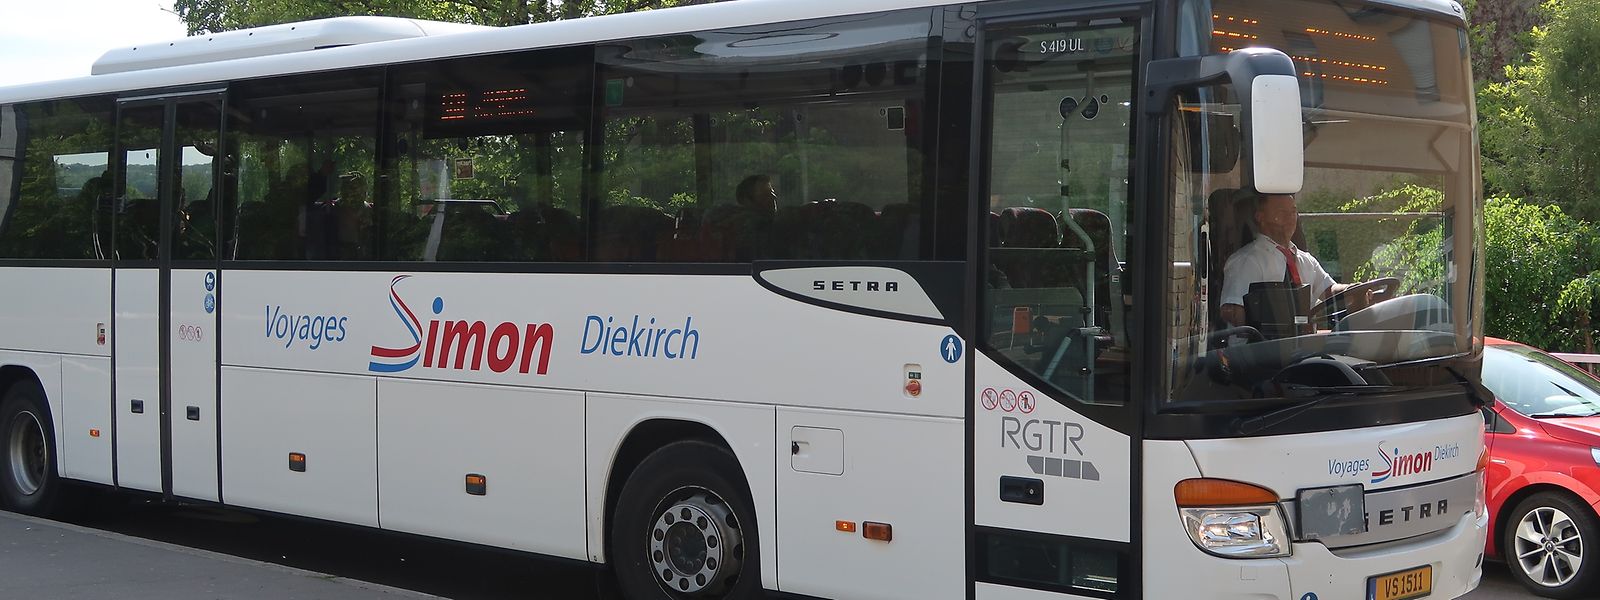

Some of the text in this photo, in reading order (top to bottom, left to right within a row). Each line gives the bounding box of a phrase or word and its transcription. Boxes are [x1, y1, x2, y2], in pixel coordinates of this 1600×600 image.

[1039, 38, 1085, 54] S 419 UL
[813, 280, 899, 292] SETRA
[264, 275, 700, 375] Voyages Simon Diekirch
[1001, 416, 1085, 456] RGTR
[1328, 440, 1460, 484] Voyages Simon Diekirch
[1385, 570, 1423, 598] VS 1511
